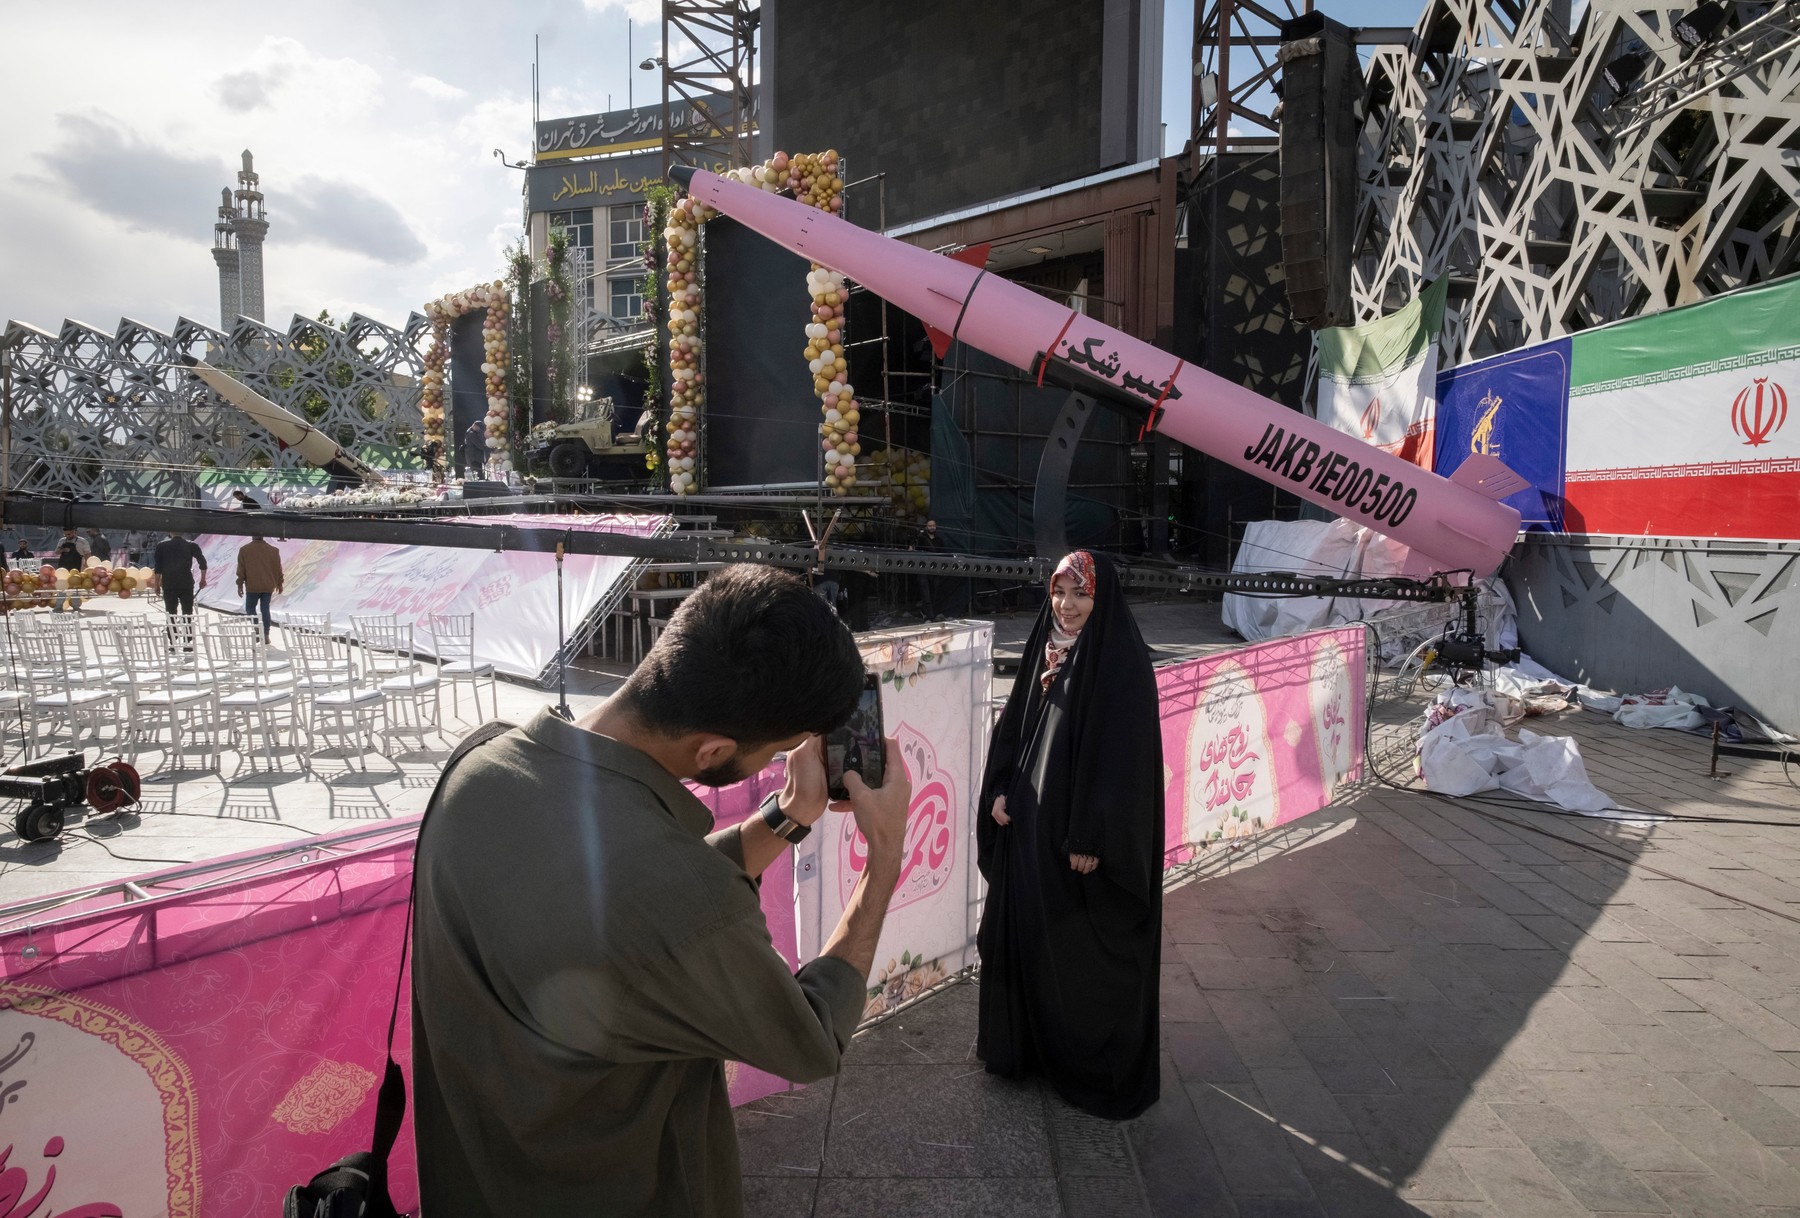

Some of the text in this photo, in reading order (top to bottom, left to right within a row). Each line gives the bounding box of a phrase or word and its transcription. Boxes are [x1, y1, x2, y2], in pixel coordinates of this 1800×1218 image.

[538, 120, 575, 152] تهران
[569, 114, 605, 149] شرق
[657, 110, 685, 131] اداه
[552, 169, 599, 202] السلام
[1243, 423, 1418, 528] JAKB1E00500
